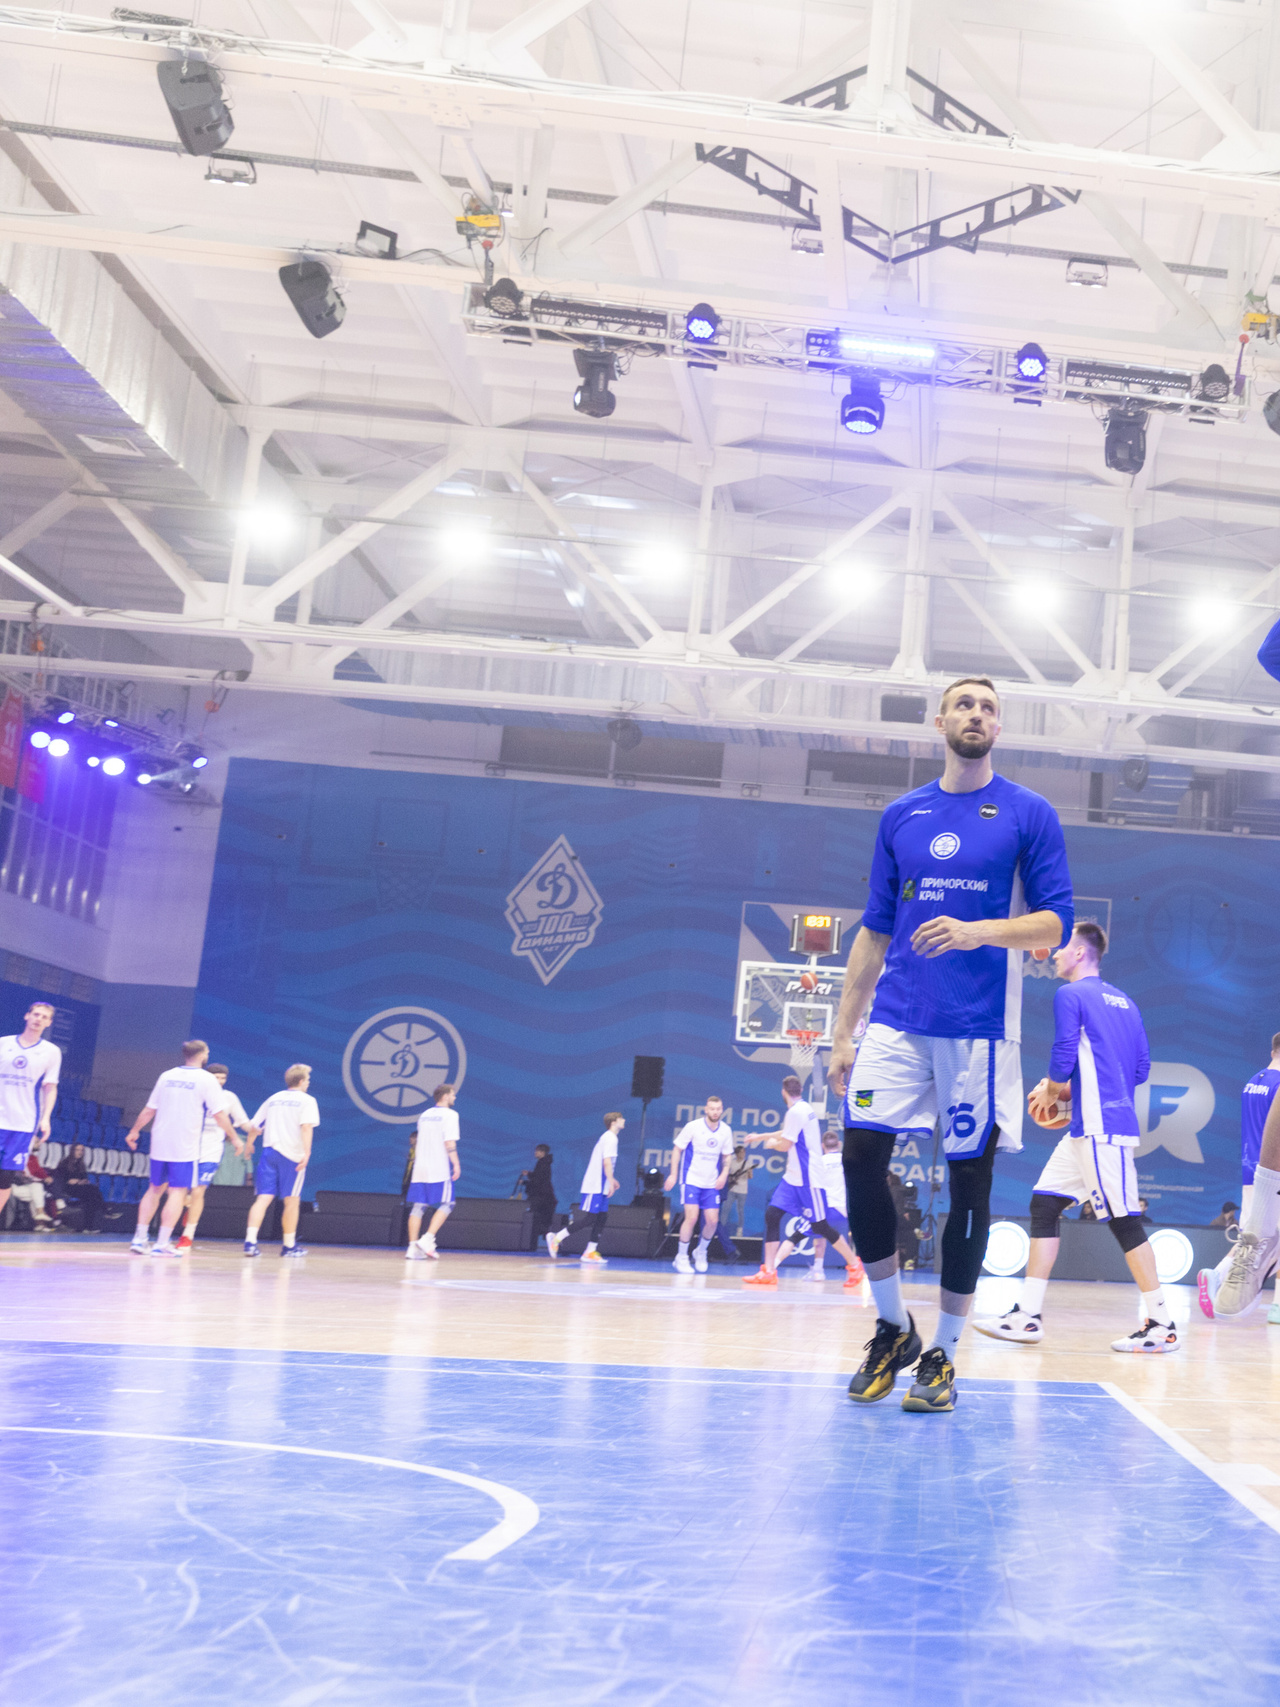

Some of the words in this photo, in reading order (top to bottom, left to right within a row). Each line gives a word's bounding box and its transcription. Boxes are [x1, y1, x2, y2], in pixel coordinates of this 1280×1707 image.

[921, 878, 989, 892] ПРИМОРСКИЙ
[918, 889, 945, 902] КРАЙ
[519, 931, 588, 948] ДИНАМО
[888, 1162, 946, 1184] РАЯ
